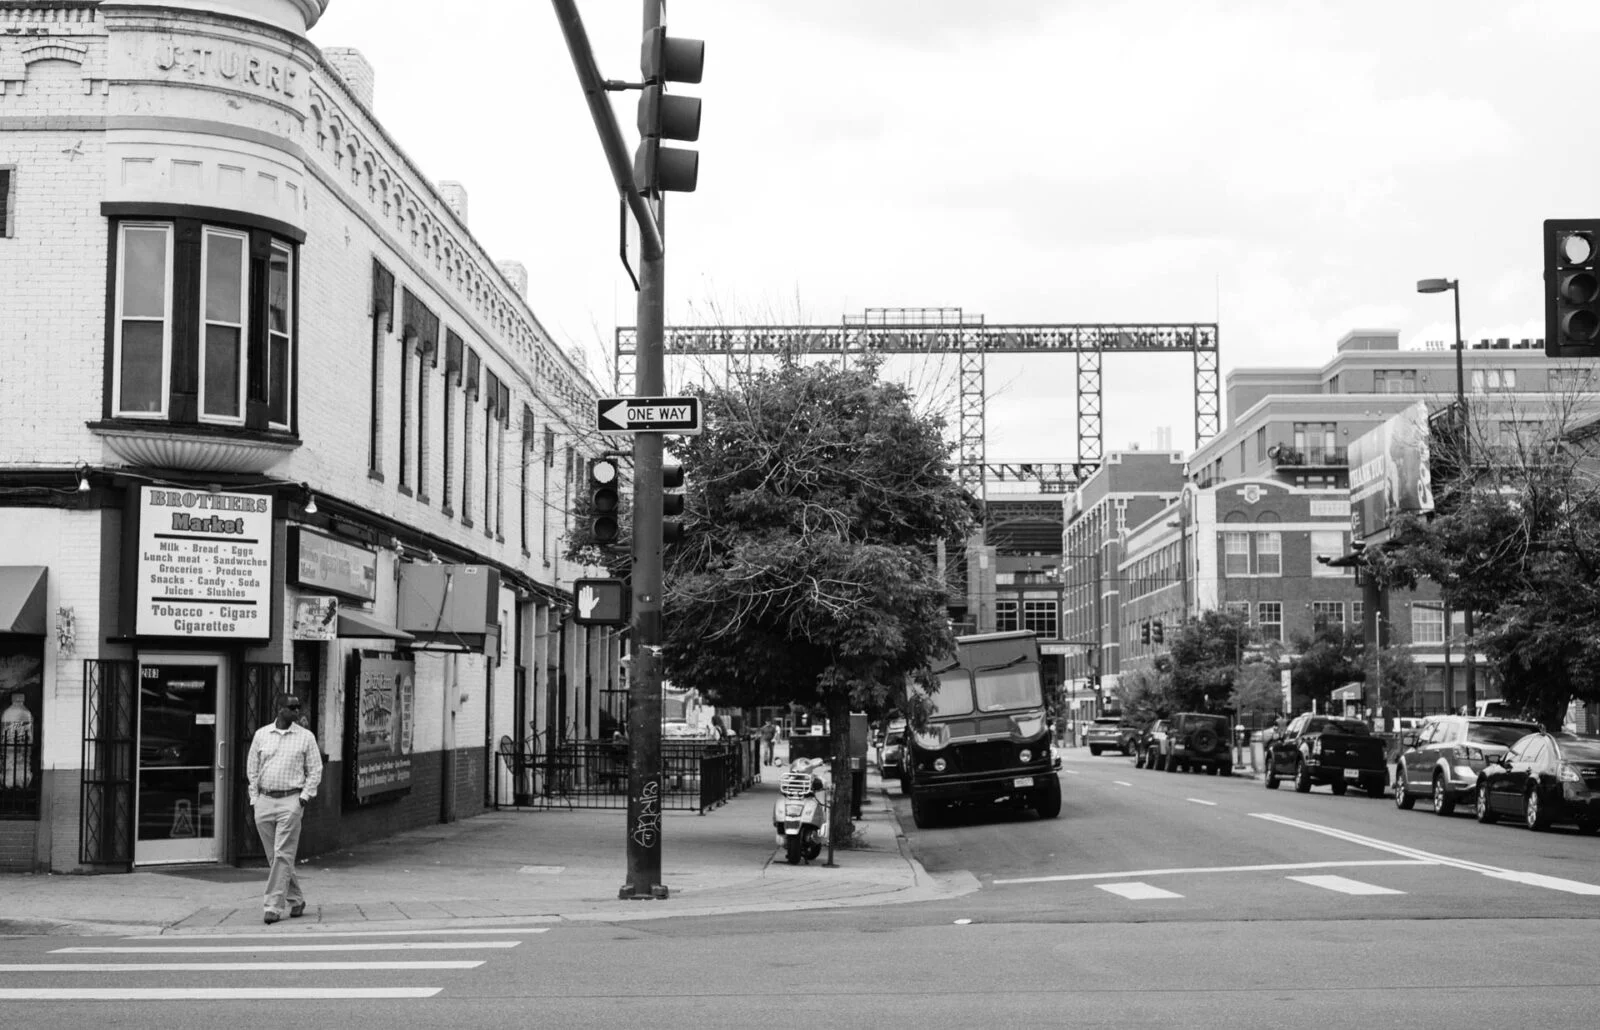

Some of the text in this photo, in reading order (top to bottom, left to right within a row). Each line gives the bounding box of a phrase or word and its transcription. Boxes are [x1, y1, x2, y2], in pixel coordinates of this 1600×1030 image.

[627, 407, 687, 420] ONE WAY
[1350, 454, 1384, 490] THANK YOU
[150, 490, 268, 513] BROTHERS
[172, 512, 244, 534] Market
[160, 542, 253, 556] Milk Bread Eggs
[144, 552, 268, 566] Lunch meat Sandwiches
[160, 564, 252, 576] Groceries Produce
[150, 575, 260, 588] Snacks Candy Soda
[164, 586, 246, 597] Juices Slushies
[152, 604, 258, 621] Tobacco Cigars
[174, 620, 236, 634] Cigarettes
